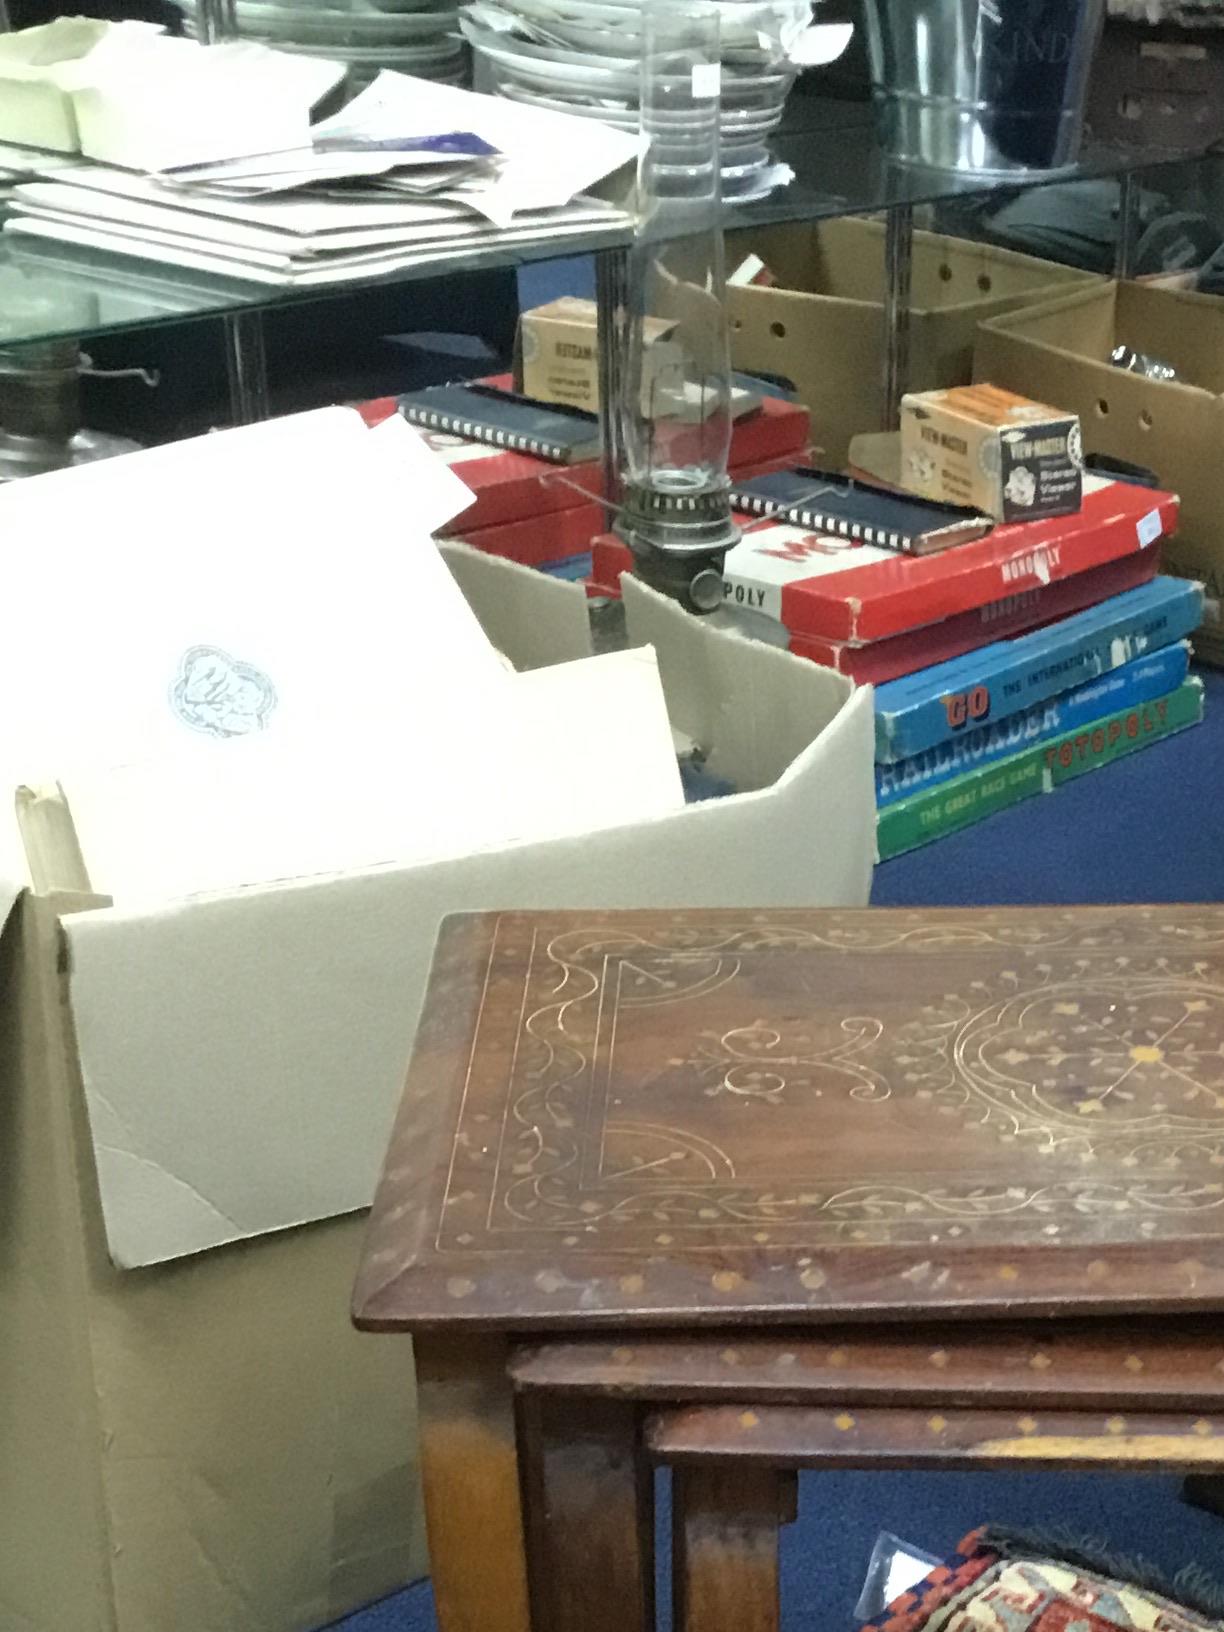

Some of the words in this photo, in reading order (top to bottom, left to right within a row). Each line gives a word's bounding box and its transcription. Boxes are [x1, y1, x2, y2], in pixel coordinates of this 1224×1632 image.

[1002, 547, 1061, 584] MONOLY
[939, 685, 991, 731] GO
[1003, 680, 1022, 697] THE
[1045, 699, 1168, 768] TOTOPOLY
[880, 703, 1060, 796] RAILROADER
[920, 807, 940, 825] THE
[945, 792, 976, 817] GREAT
[981, 778, 1007, 799] RACE
[1010, 763, 1037, 783] GAME
